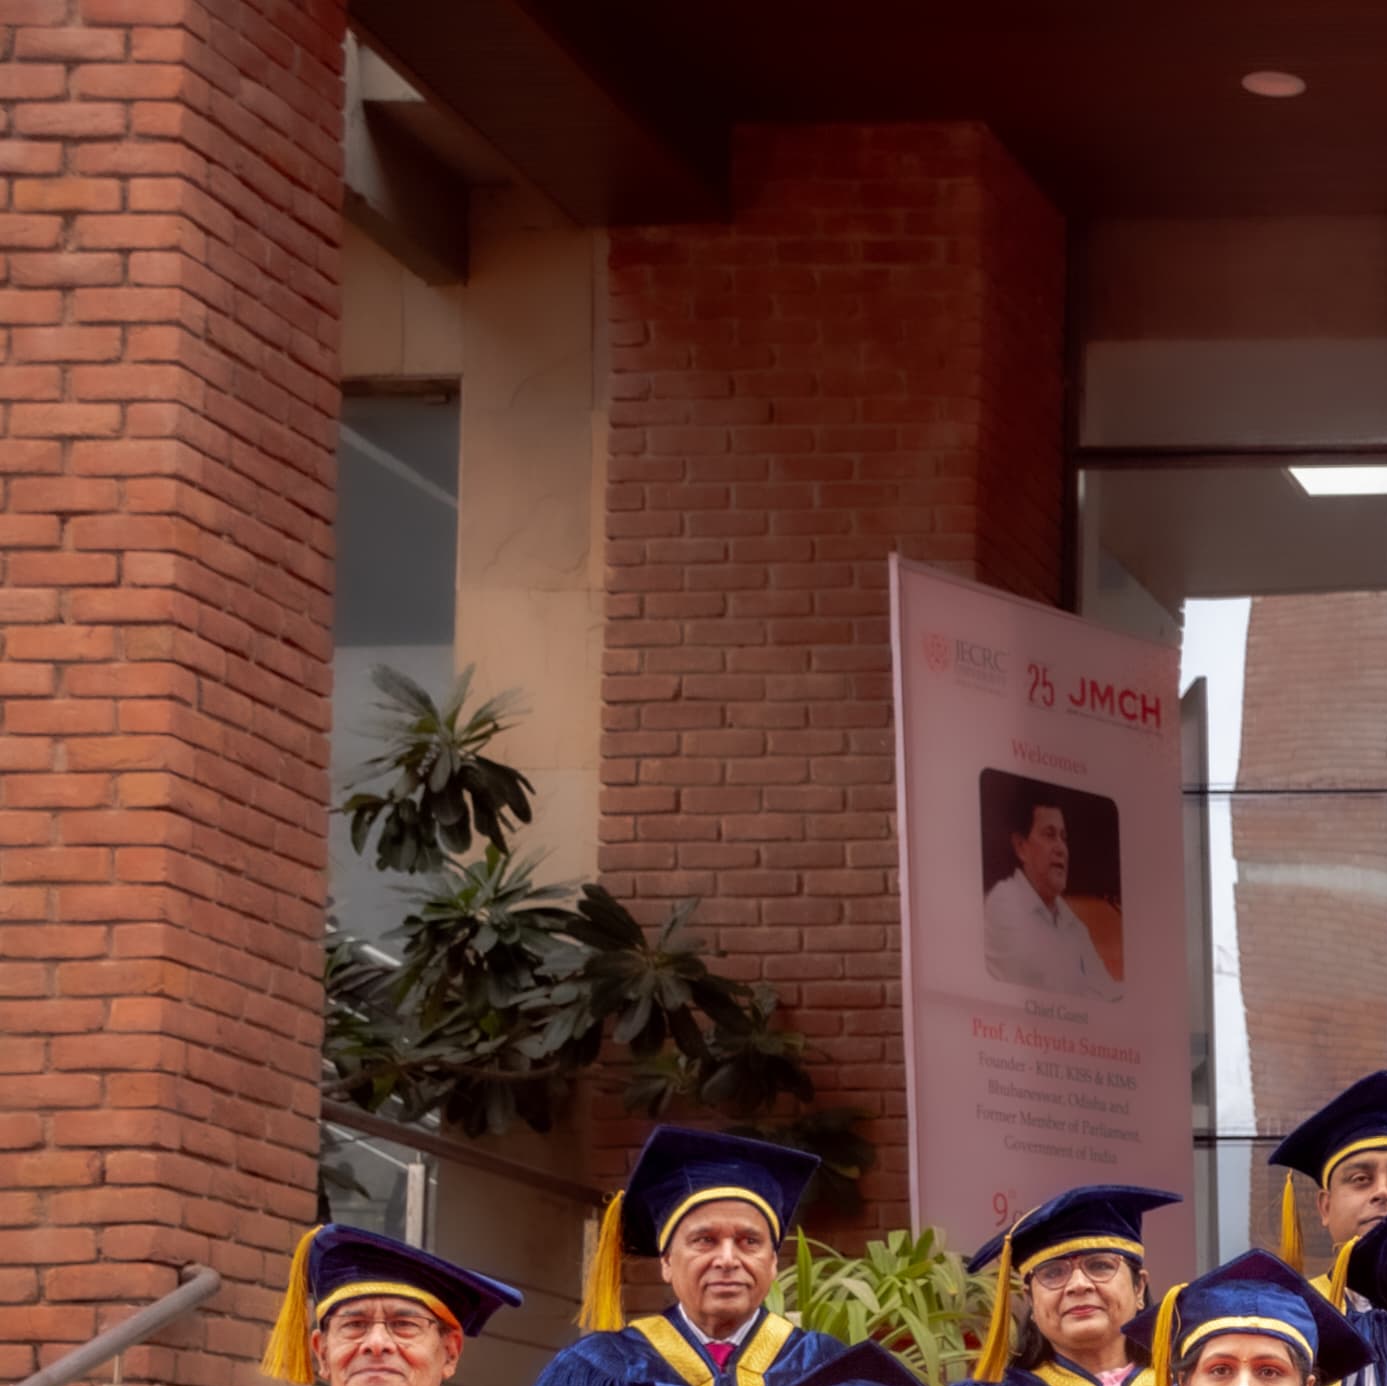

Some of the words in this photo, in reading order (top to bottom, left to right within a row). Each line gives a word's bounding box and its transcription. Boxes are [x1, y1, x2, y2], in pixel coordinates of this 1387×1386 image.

[1027, 663, 1056, 708] 25
[1068, 677, 1162, 729] JMCH
[1011, 739, 1088, 775] Welcomes
[972, 1017, 1009, 1042] Prof.
[1013, 1024, 1076, 1055] Achyuta
[1079, 1037, 1141, 1065] Samanta
[978, 1051, 1025, 1073] Founder
[976, 1104, 1017, 1125] Former
[1020, 1111, 1066, 1131] Member
[1003, 1135, 1073, 1160] Government
